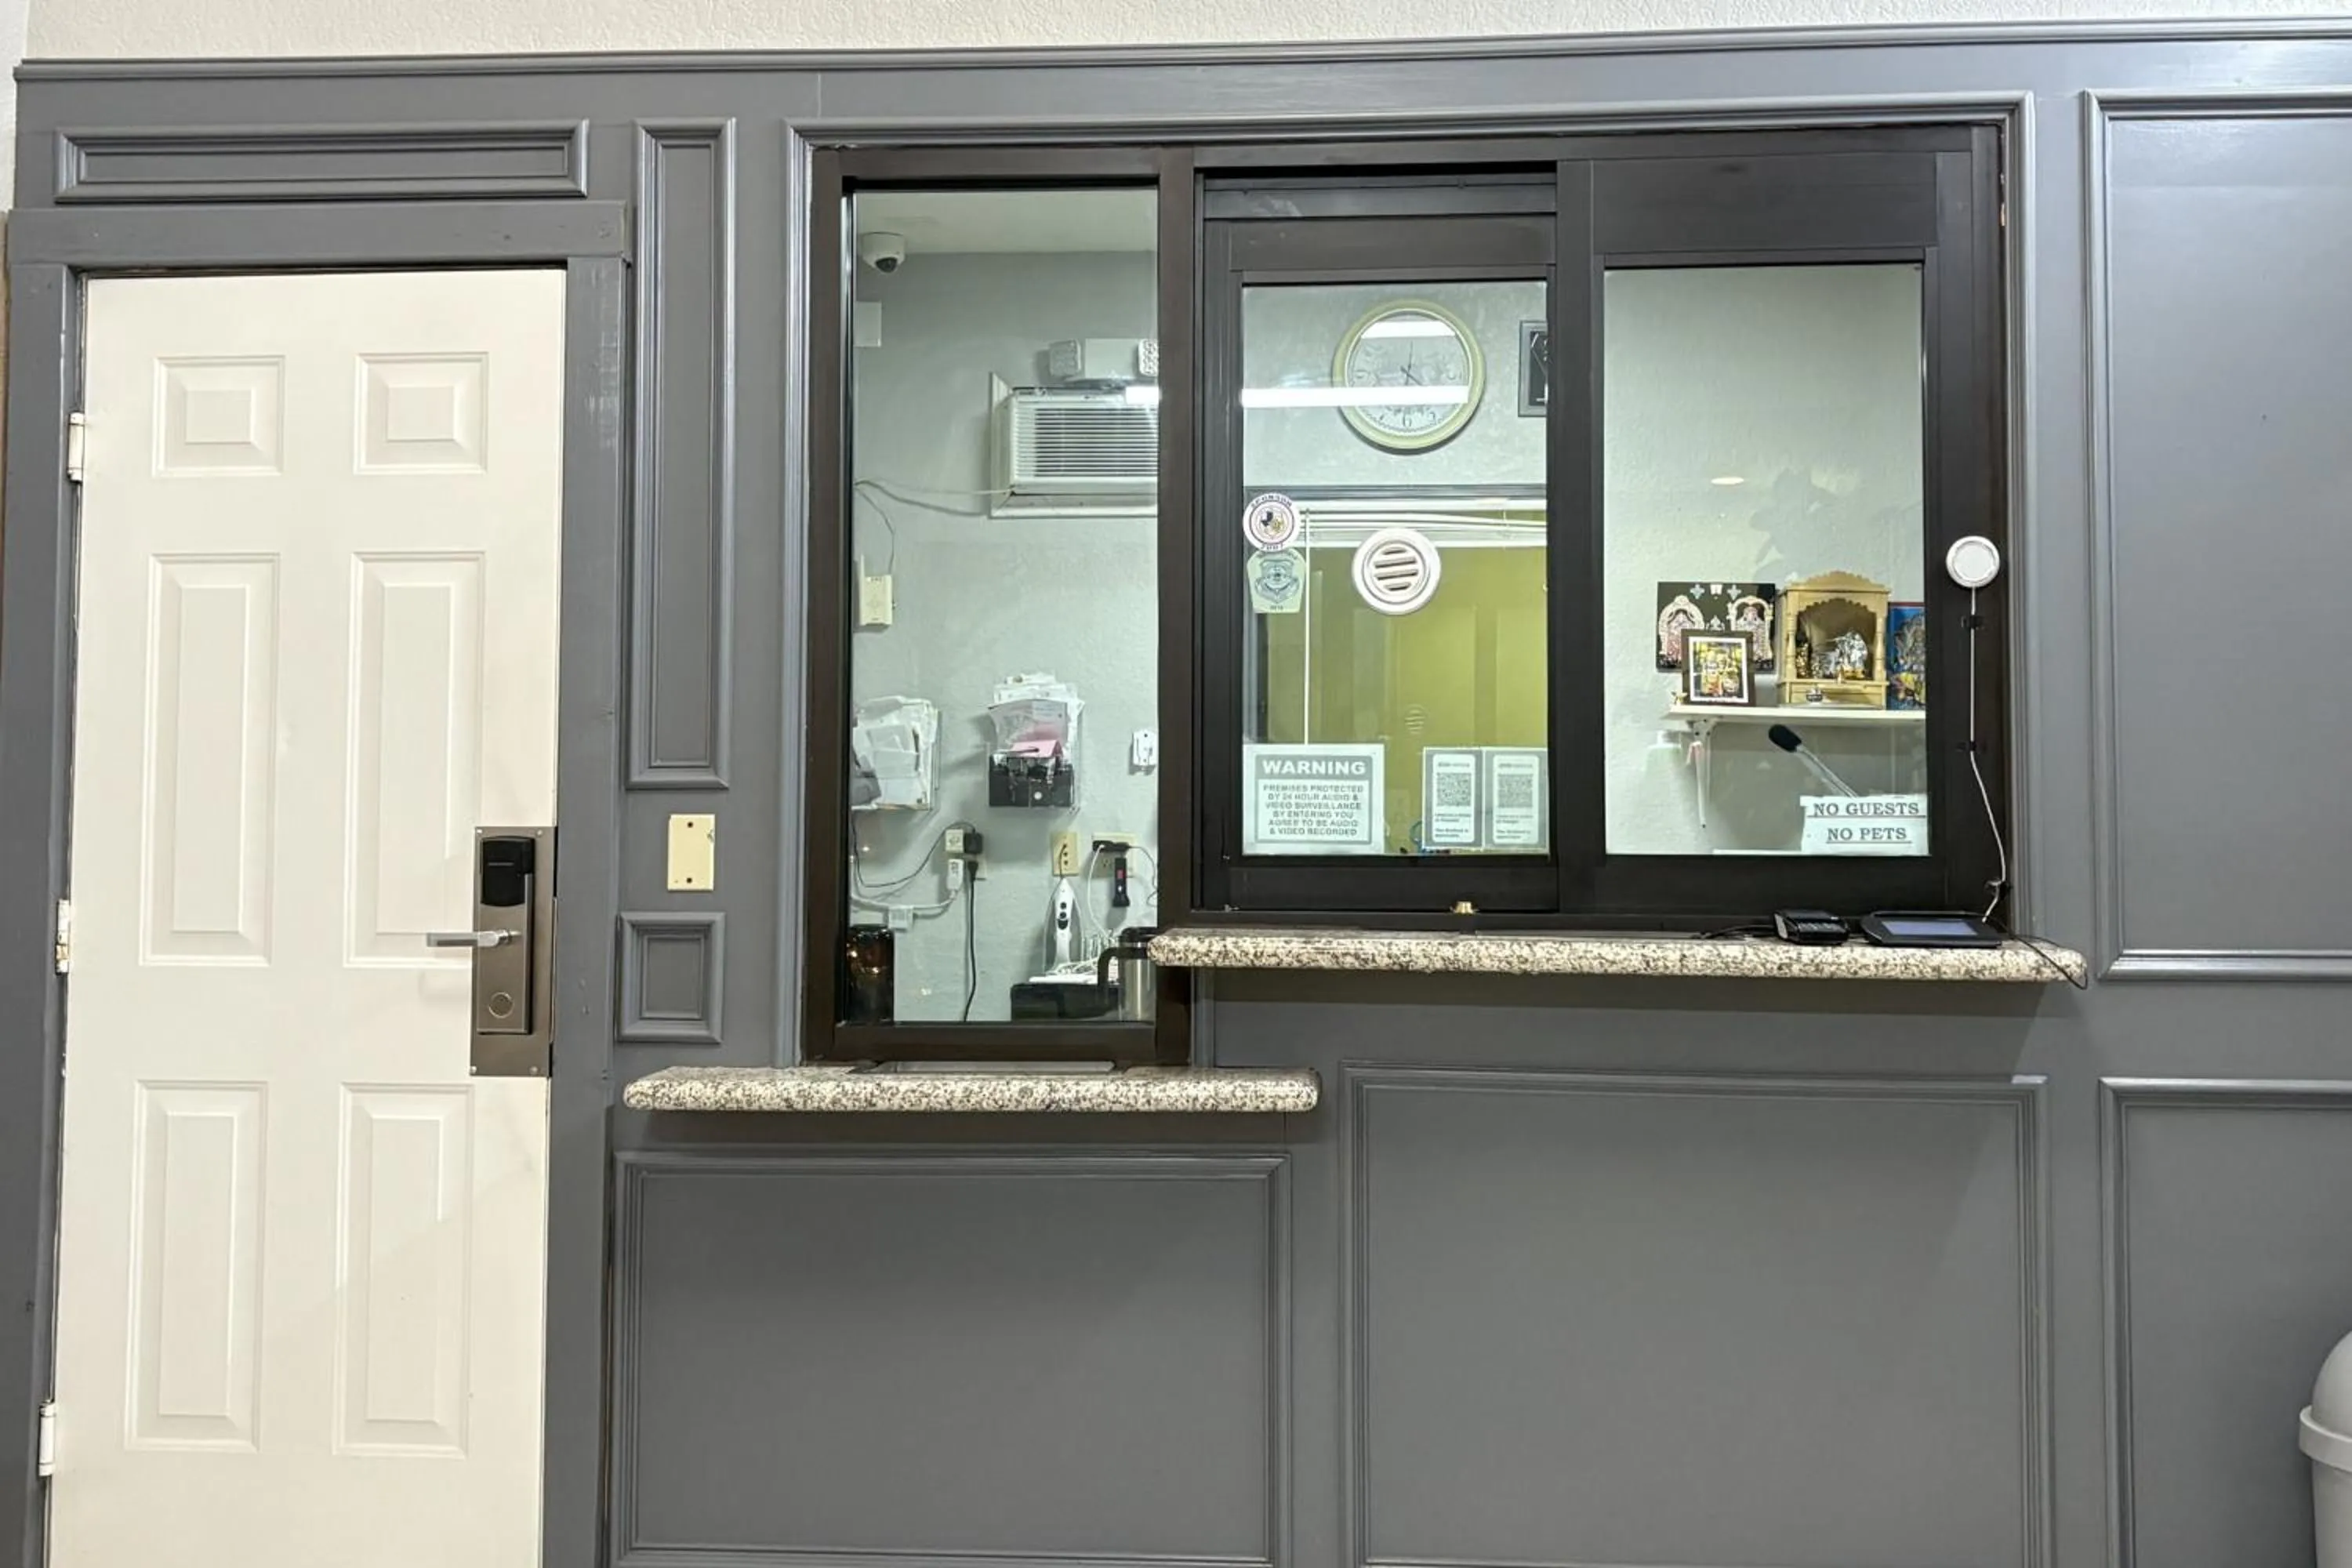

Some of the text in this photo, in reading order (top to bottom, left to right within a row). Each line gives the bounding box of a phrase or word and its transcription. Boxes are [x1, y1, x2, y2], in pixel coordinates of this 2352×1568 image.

[1261, 760, 1367, 775] WARNING
[1310, 784, 1363, 793] PROTECTED
[1813, 802, 1919, 816] NO GUESTS
[1827, 827, 1907, 840] NO PETS
